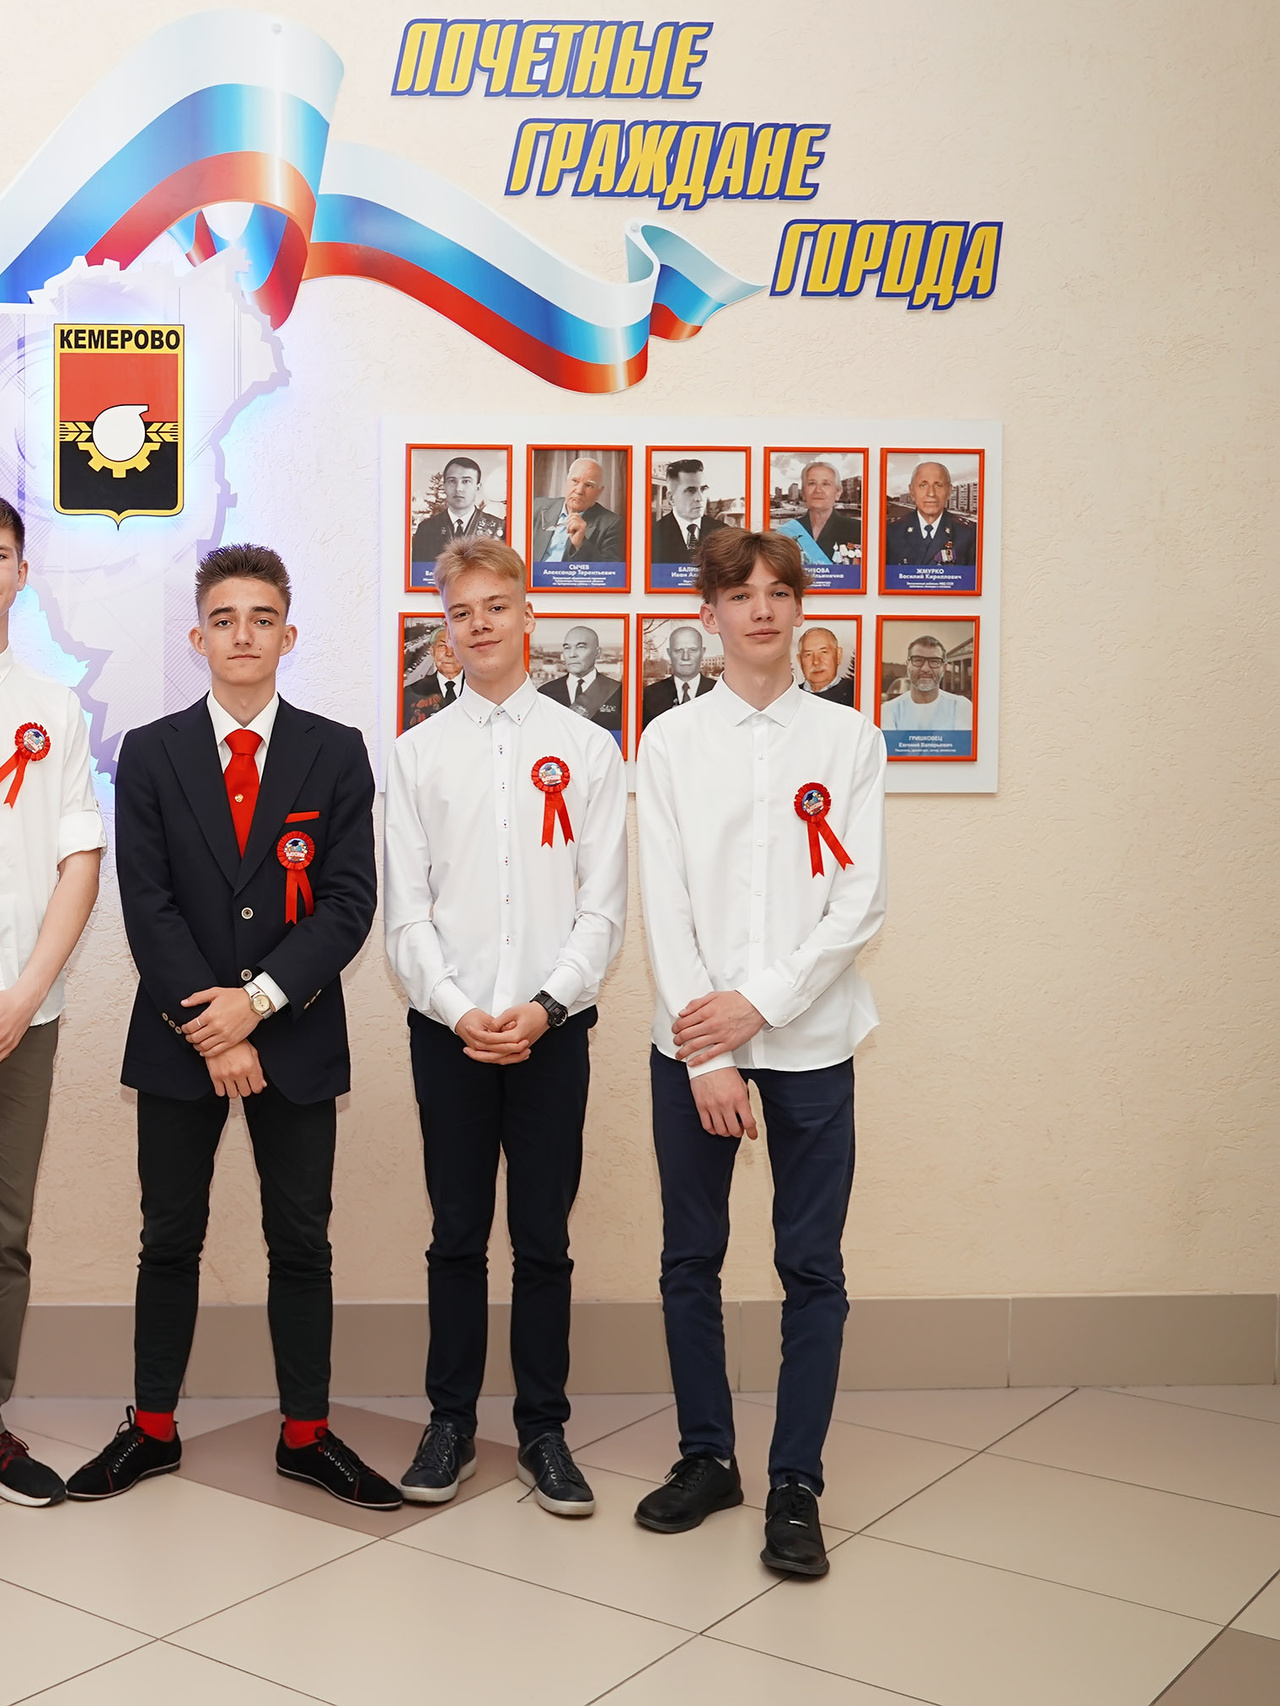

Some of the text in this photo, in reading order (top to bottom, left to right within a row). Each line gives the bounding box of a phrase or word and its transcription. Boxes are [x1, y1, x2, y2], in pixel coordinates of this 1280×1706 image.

[391, 19, 714, 99] ПОЧЕТНЫЕ
[505, 118, 831, 210] ГРАЖДАНЕ
[769, 219, 1003, 311] ГОРОДА
[60, 329, 180, 349] КЕМЕРОВО
